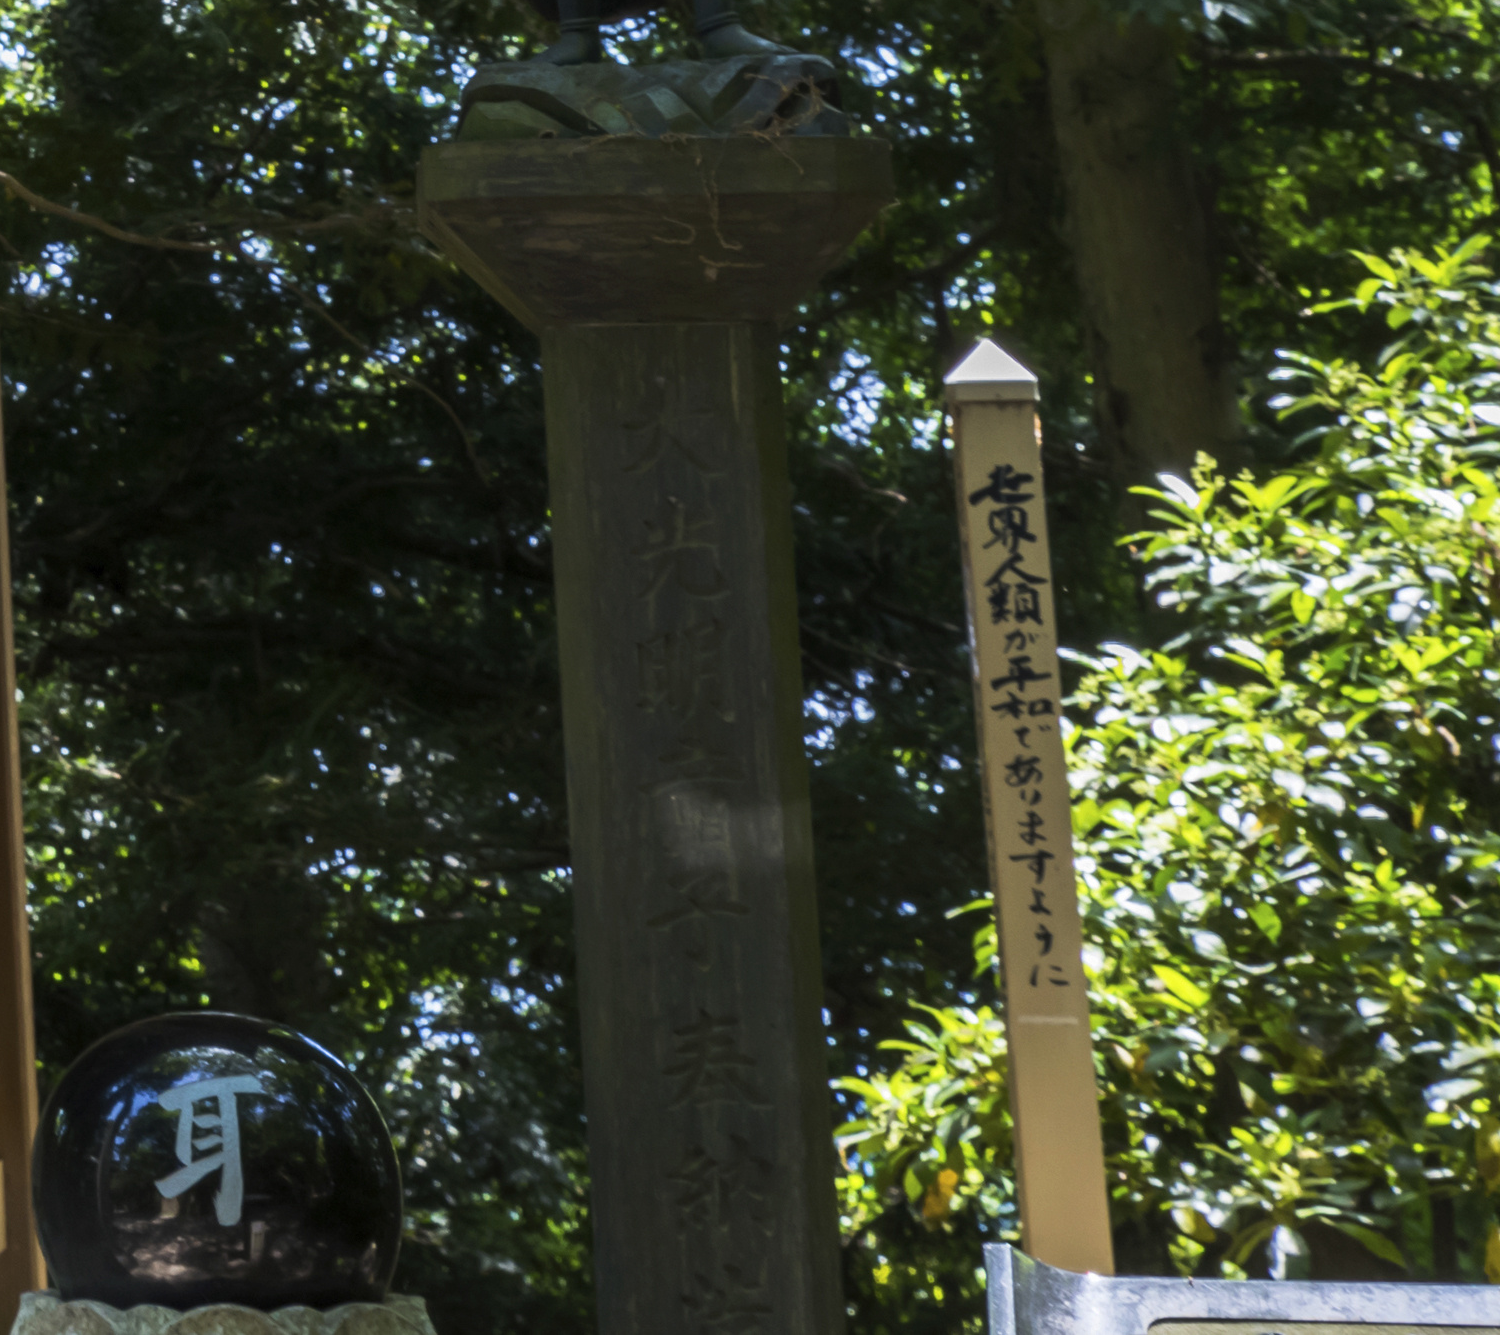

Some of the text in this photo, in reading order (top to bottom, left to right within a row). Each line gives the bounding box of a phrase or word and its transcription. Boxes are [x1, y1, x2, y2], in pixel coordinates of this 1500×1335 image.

[969, 463, 1072, 990] 世界人類が平和でありますように
